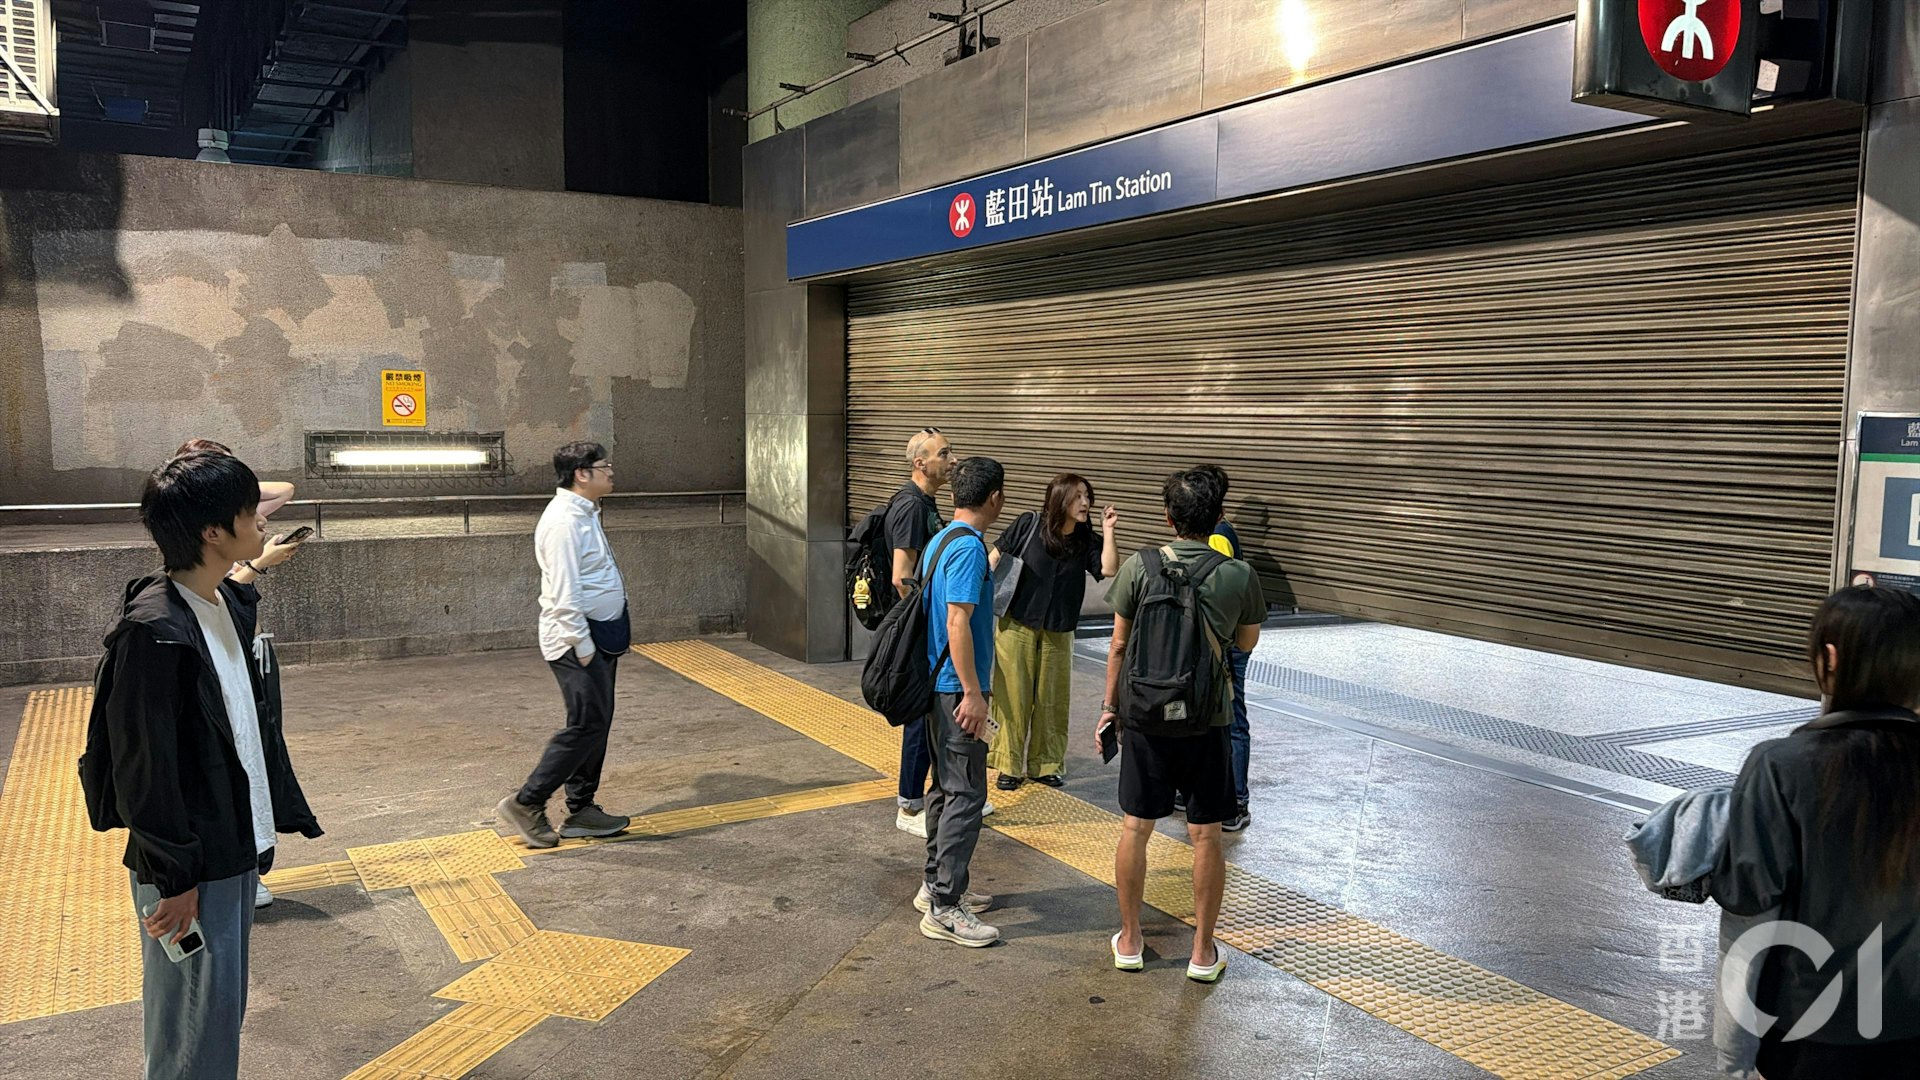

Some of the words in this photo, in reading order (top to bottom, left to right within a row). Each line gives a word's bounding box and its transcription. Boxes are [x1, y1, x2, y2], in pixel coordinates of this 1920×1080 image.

[985, 177, 1054, 227] 藍田站
[1058, 191, 1087, 212] Lam
[1089, 181, 1112, 204] Tin
[1115, 169, 1171, 199] Station
[1900, 438, 1919, 447] Lam
